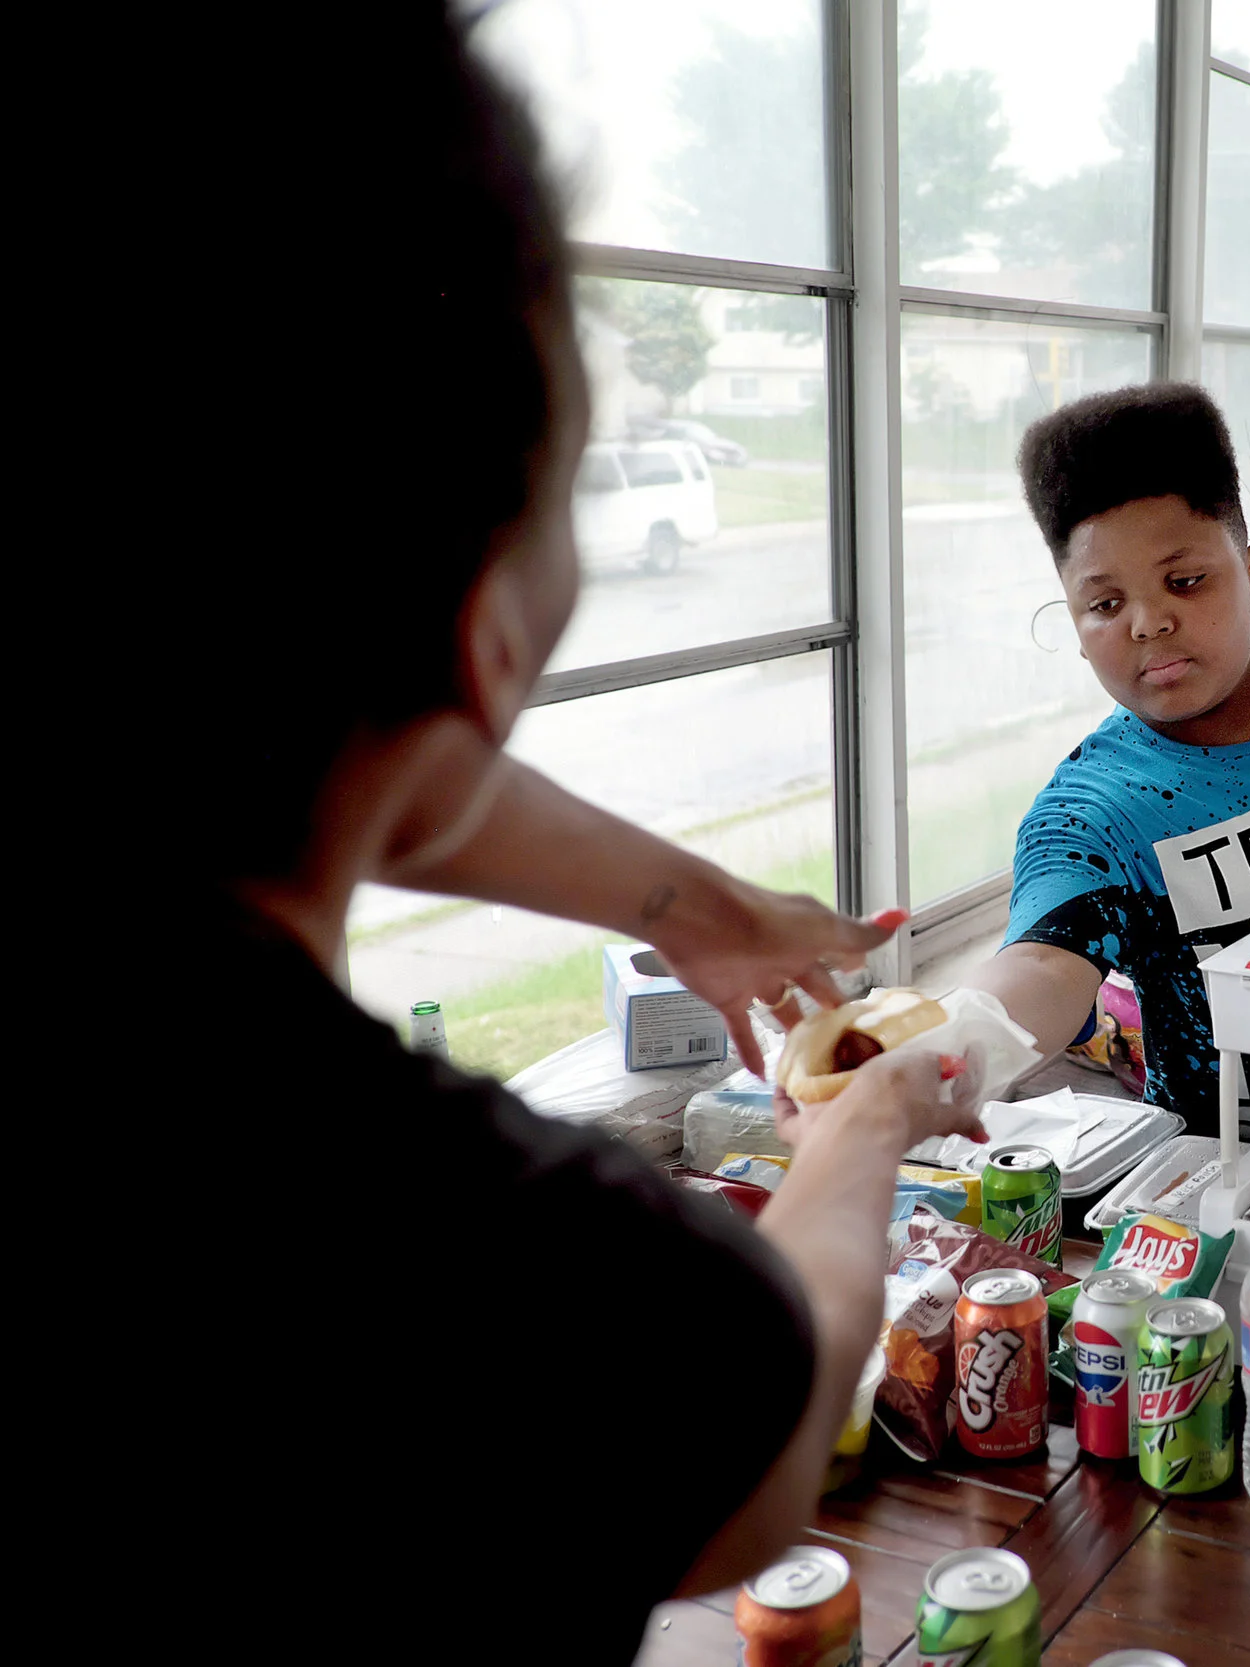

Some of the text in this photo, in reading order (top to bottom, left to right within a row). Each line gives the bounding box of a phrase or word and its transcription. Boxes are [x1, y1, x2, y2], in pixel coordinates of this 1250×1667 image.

[1108, 1226, 1195, 1276] Lay's
[959, 1329, 1025, 1433] Crush
[1076, 1347, 1126, 1370] EPSI
[993, 1359, 1020, 1413] Orange
[1138, 1368, 1212, 1420] ew
